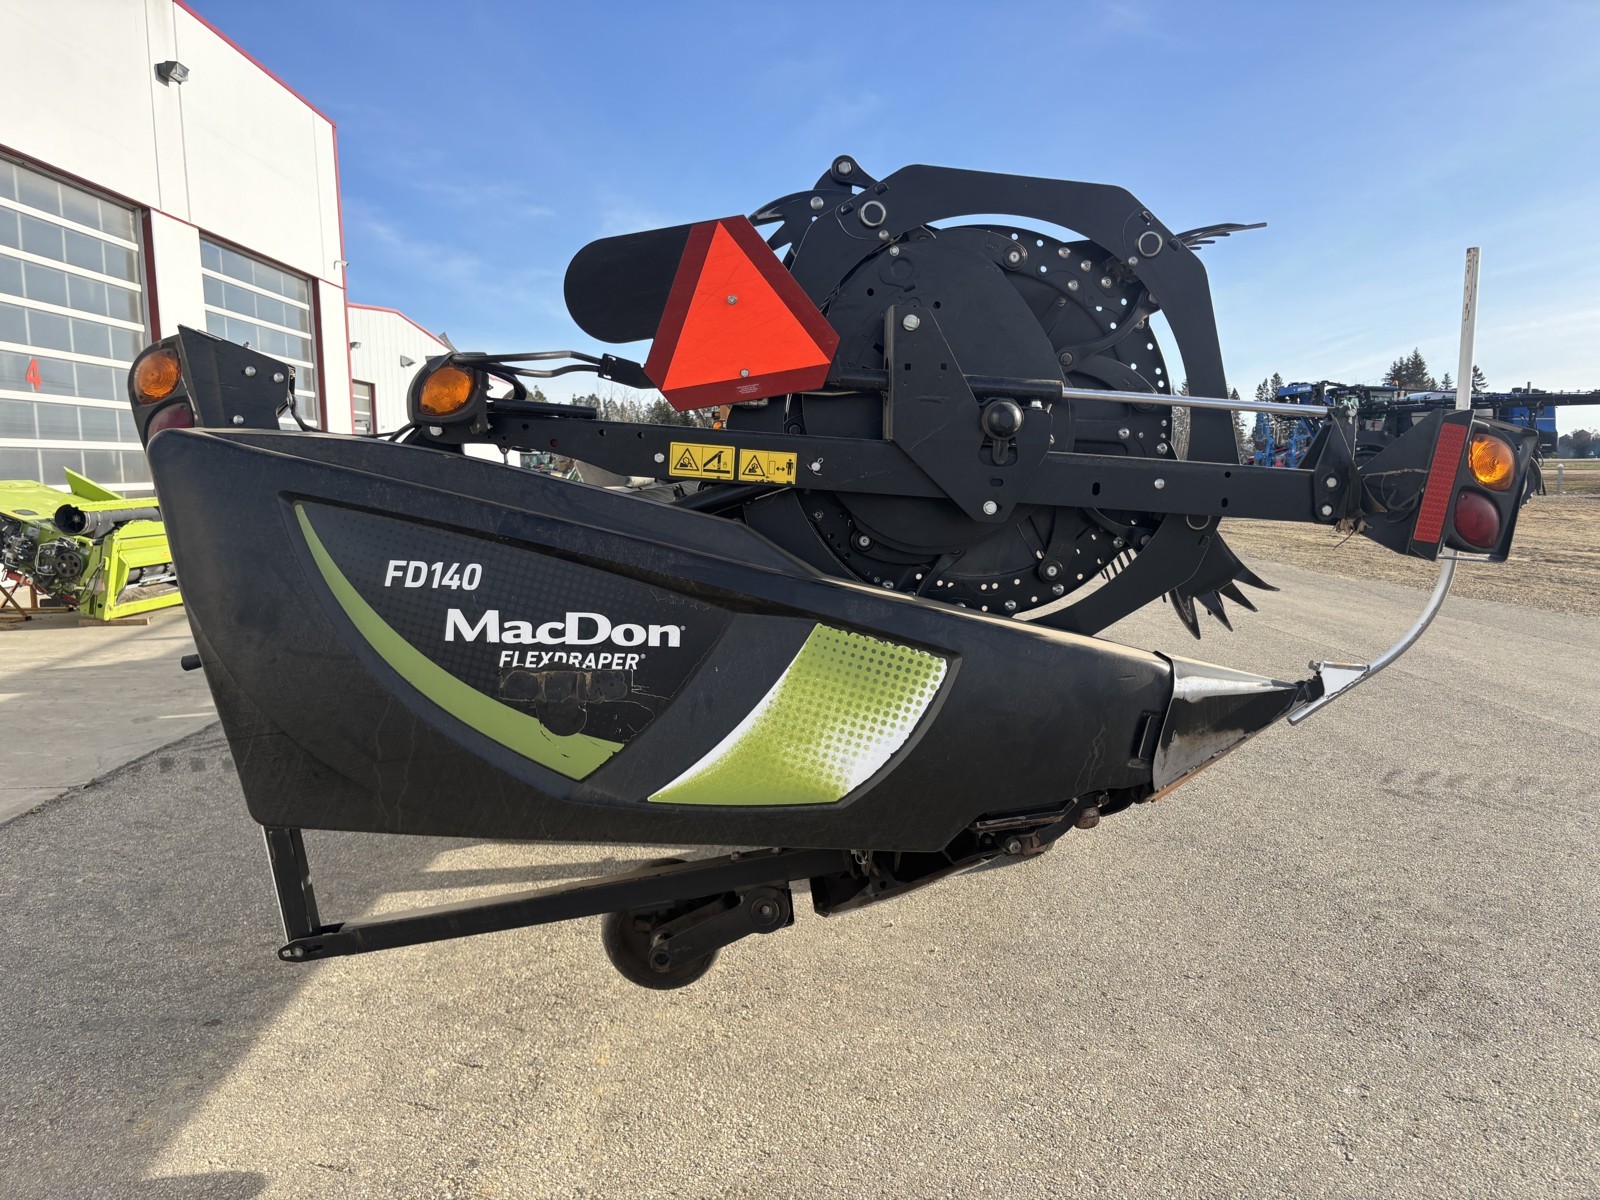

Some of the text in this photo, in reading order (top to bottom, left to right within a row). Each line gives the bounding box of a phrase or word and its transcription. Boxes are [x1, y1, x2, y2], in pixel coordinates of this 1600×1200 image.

[26, 358, 42, 391] 4
[384, 560, 482, 591] FD140
[444, 608, 681, 648] MacDon
[499, 650, 640, 670] FLEXDRAPER
